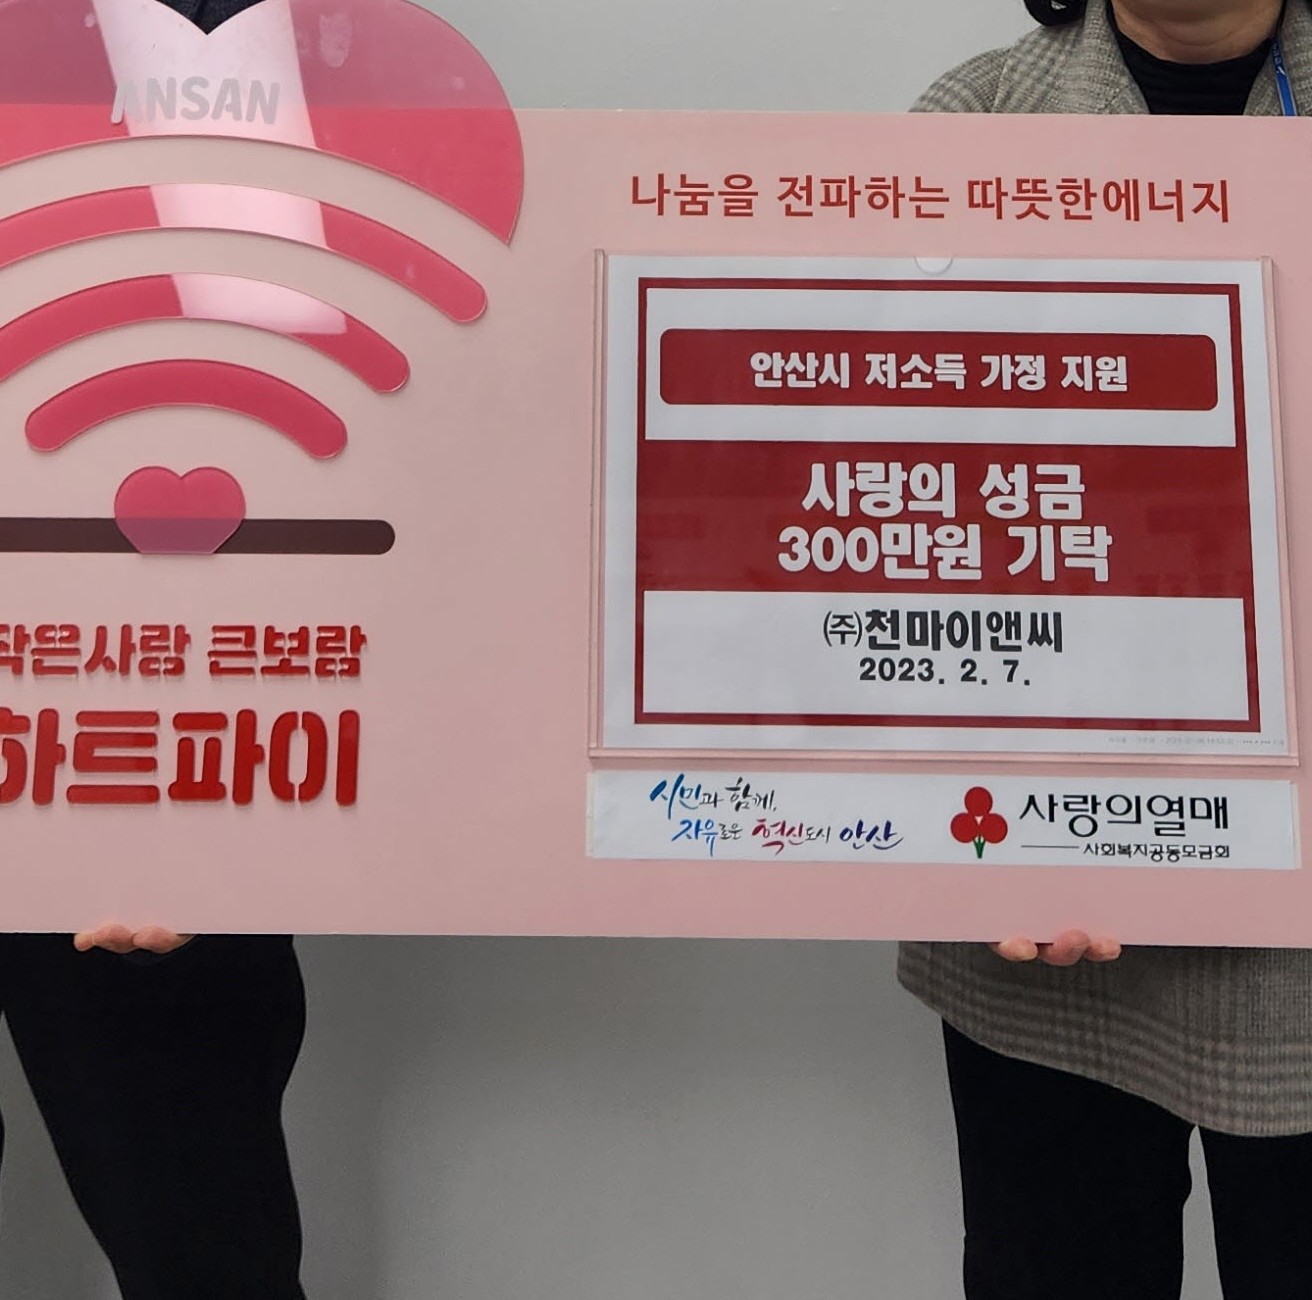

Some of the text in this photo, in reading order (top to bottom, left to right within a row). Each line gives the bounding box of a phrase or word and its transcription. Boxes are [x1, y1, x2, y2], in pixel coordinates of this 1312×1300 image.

[111, 77, 281, 125] ANSAN
[632, 173, 1228, 223] 나눔을 전파하는 따뜻한에너지
[750, 352, 1127, 391] 안산시 저소득 가정 지원
[802, 462, 1085, 520] 사랑의 성금
[778, 523, 1112, 581] 300만원 기탁
[207, 624, 366, 678] 큰보람
[860, 657, 1030, 686] 2023. 2. 7.
[649, 774, 723, 816] 시민과
[1020, 794, 1228, 837] 사랑의열매
[672, 818, 742, 856] 자유로운
[838, 819, 905, 851] 안산
[1084, 843, 1229, 863] 사회복지공동모금회
